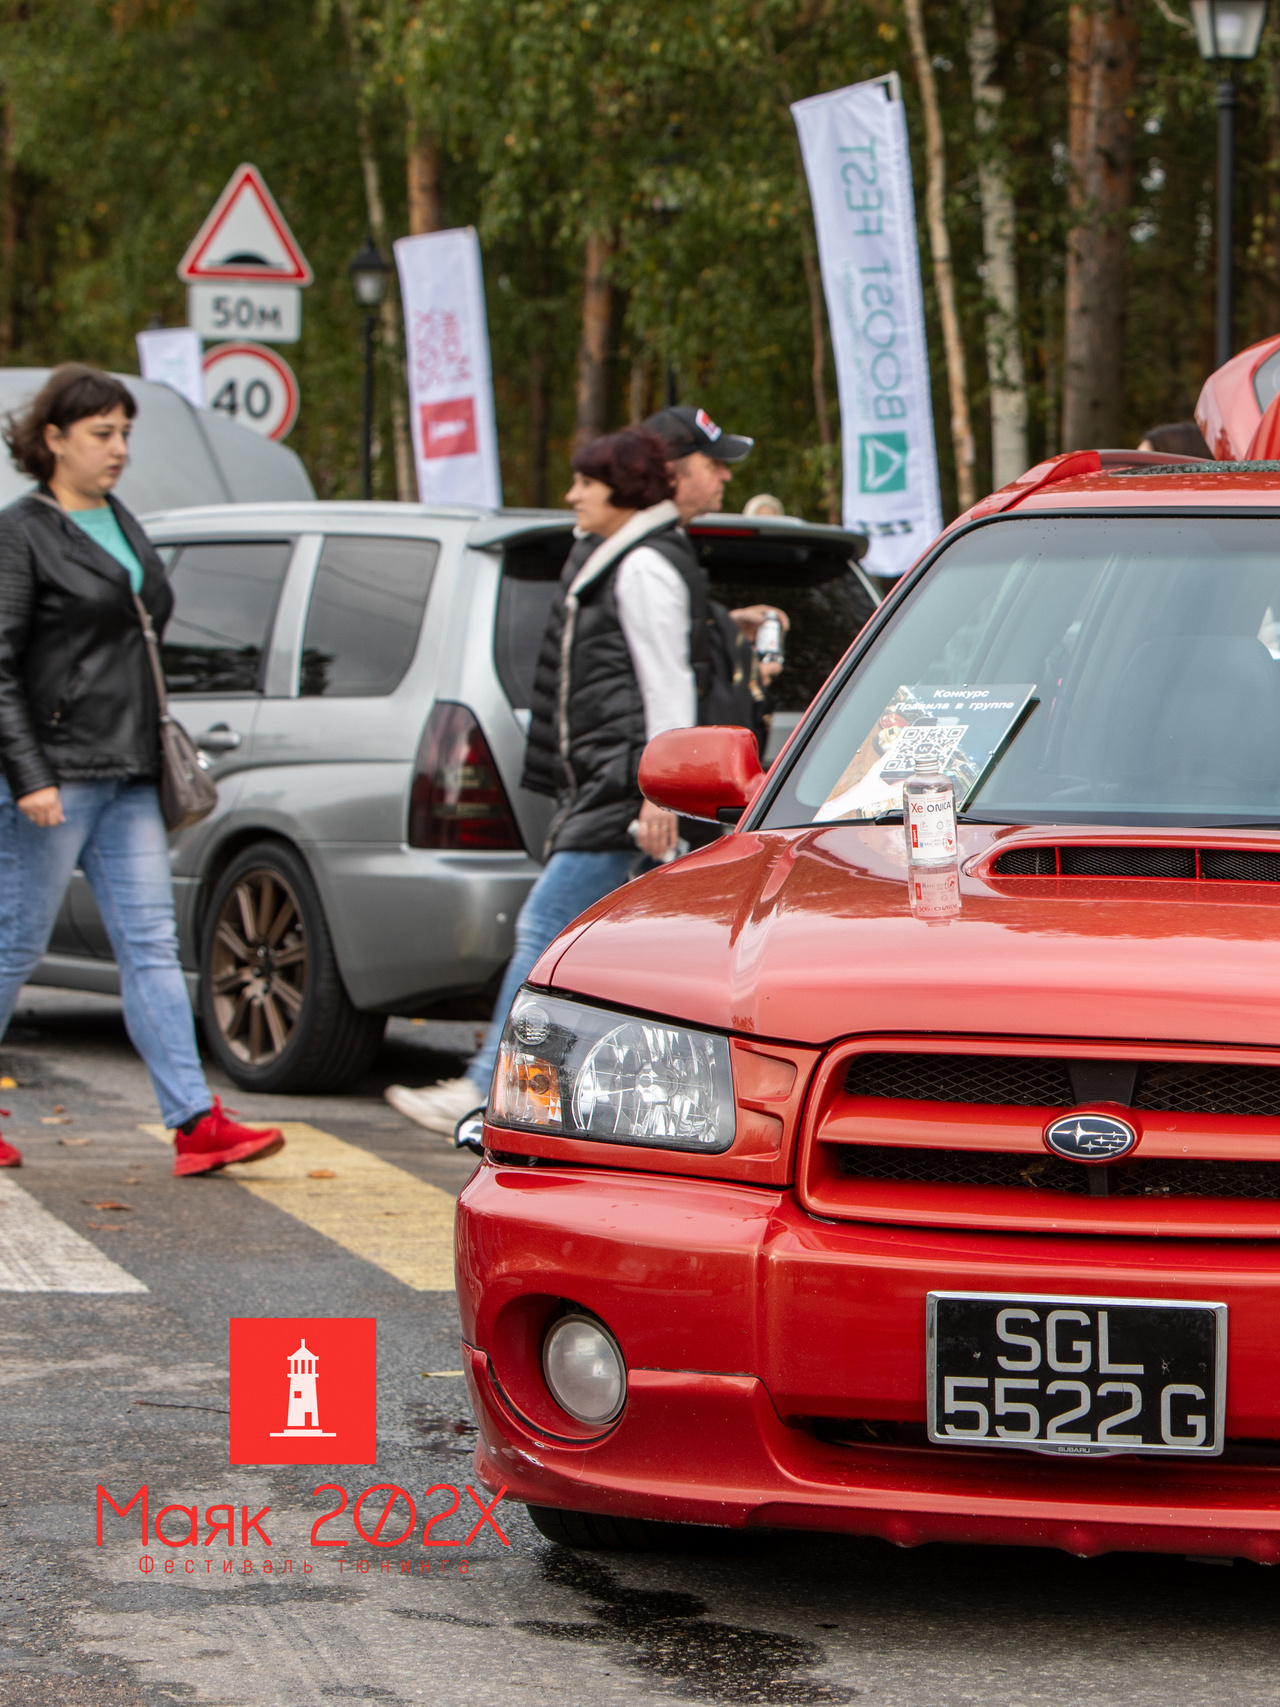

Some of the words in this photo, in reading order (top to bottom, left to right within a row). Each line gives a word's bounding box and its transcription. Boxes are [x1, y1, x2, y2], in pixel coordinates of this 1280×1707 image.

[212, 377, 272, 419] 40
[895, 702, 950, 712] Правила
[968, 702, 1015, 711] группе
[933, 689, 990, 700] Конкурс
[996, 1308, 1145, 1375] SGL
[944, 1376, 1143, 1443] 5522
[1160, 1384, 1207, 1447] G
